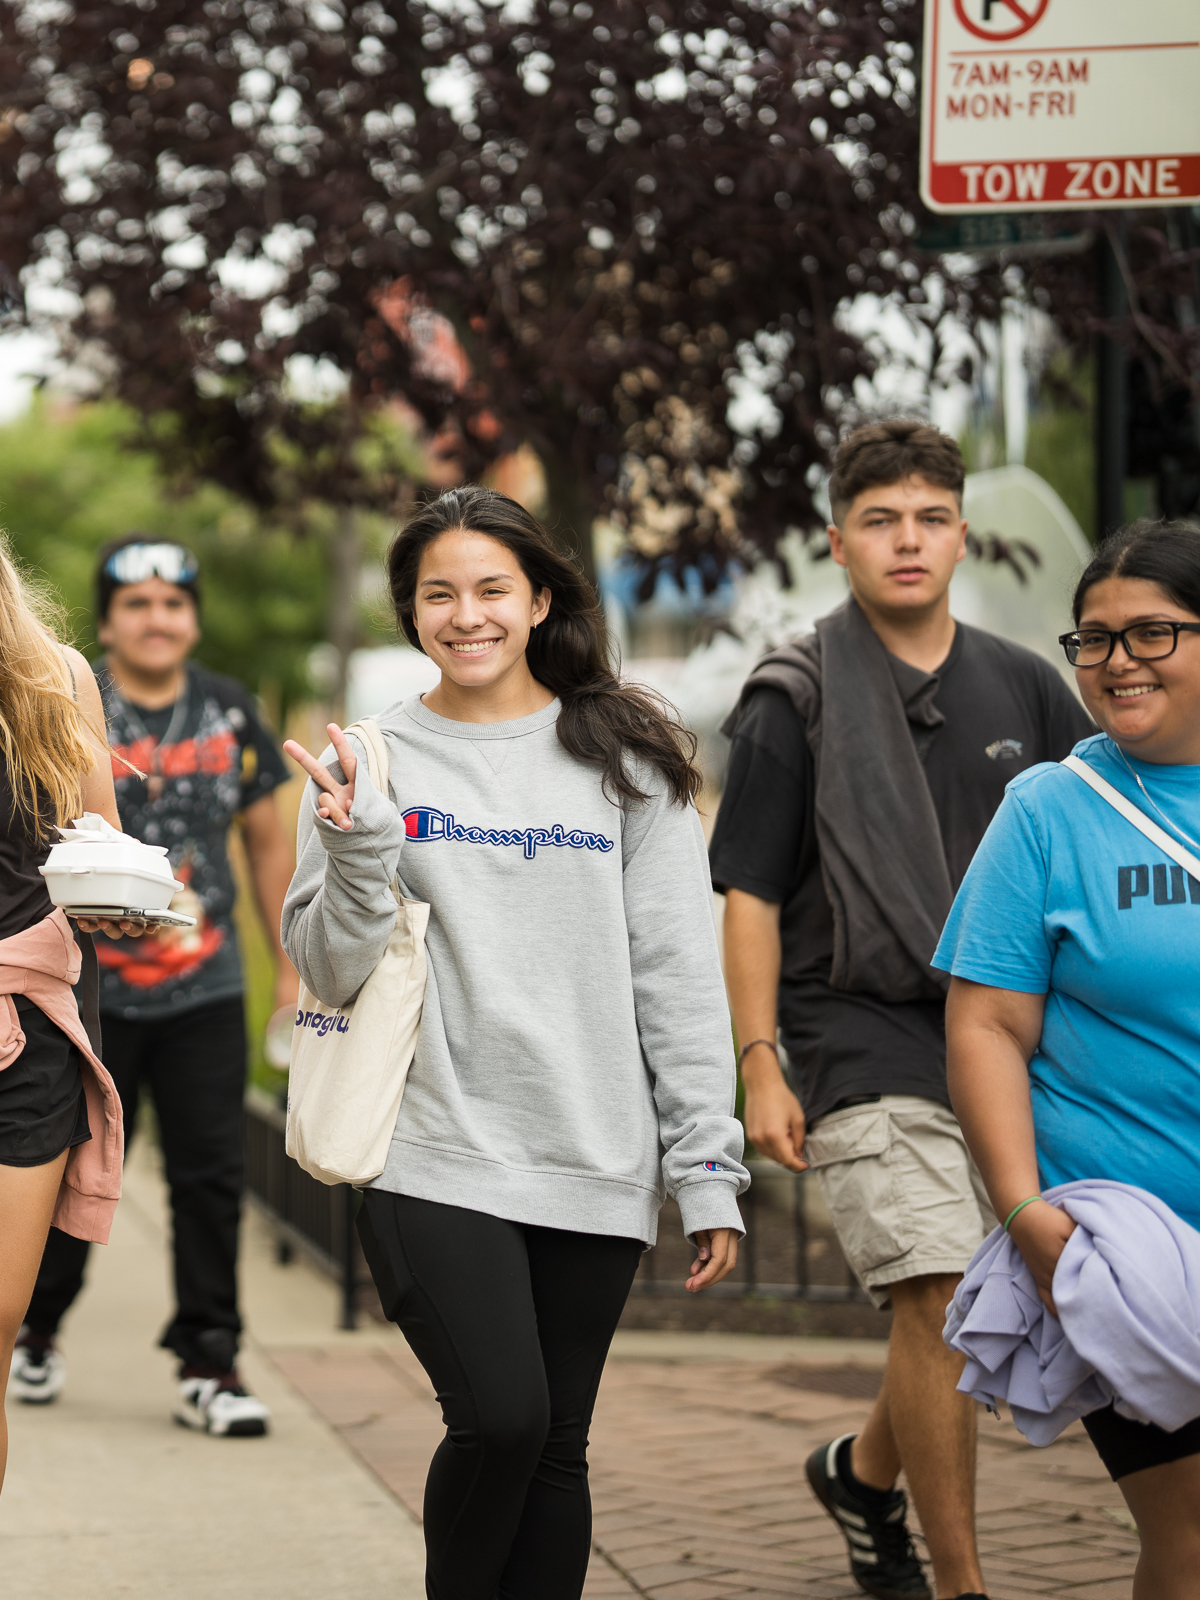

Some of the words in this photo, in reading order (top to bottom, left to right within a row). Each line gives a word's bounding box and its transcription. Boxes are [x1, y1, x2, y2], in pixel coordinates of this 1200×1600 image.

[947, 58, 1089, 87] 7AM-9AM
[945, 91, 1076, 119] MON-FRI
[960, 163, 1047, 201] TOW
[1064, 159, 1181, 199] ZONE
[401, 806, 614, 859] Champion
